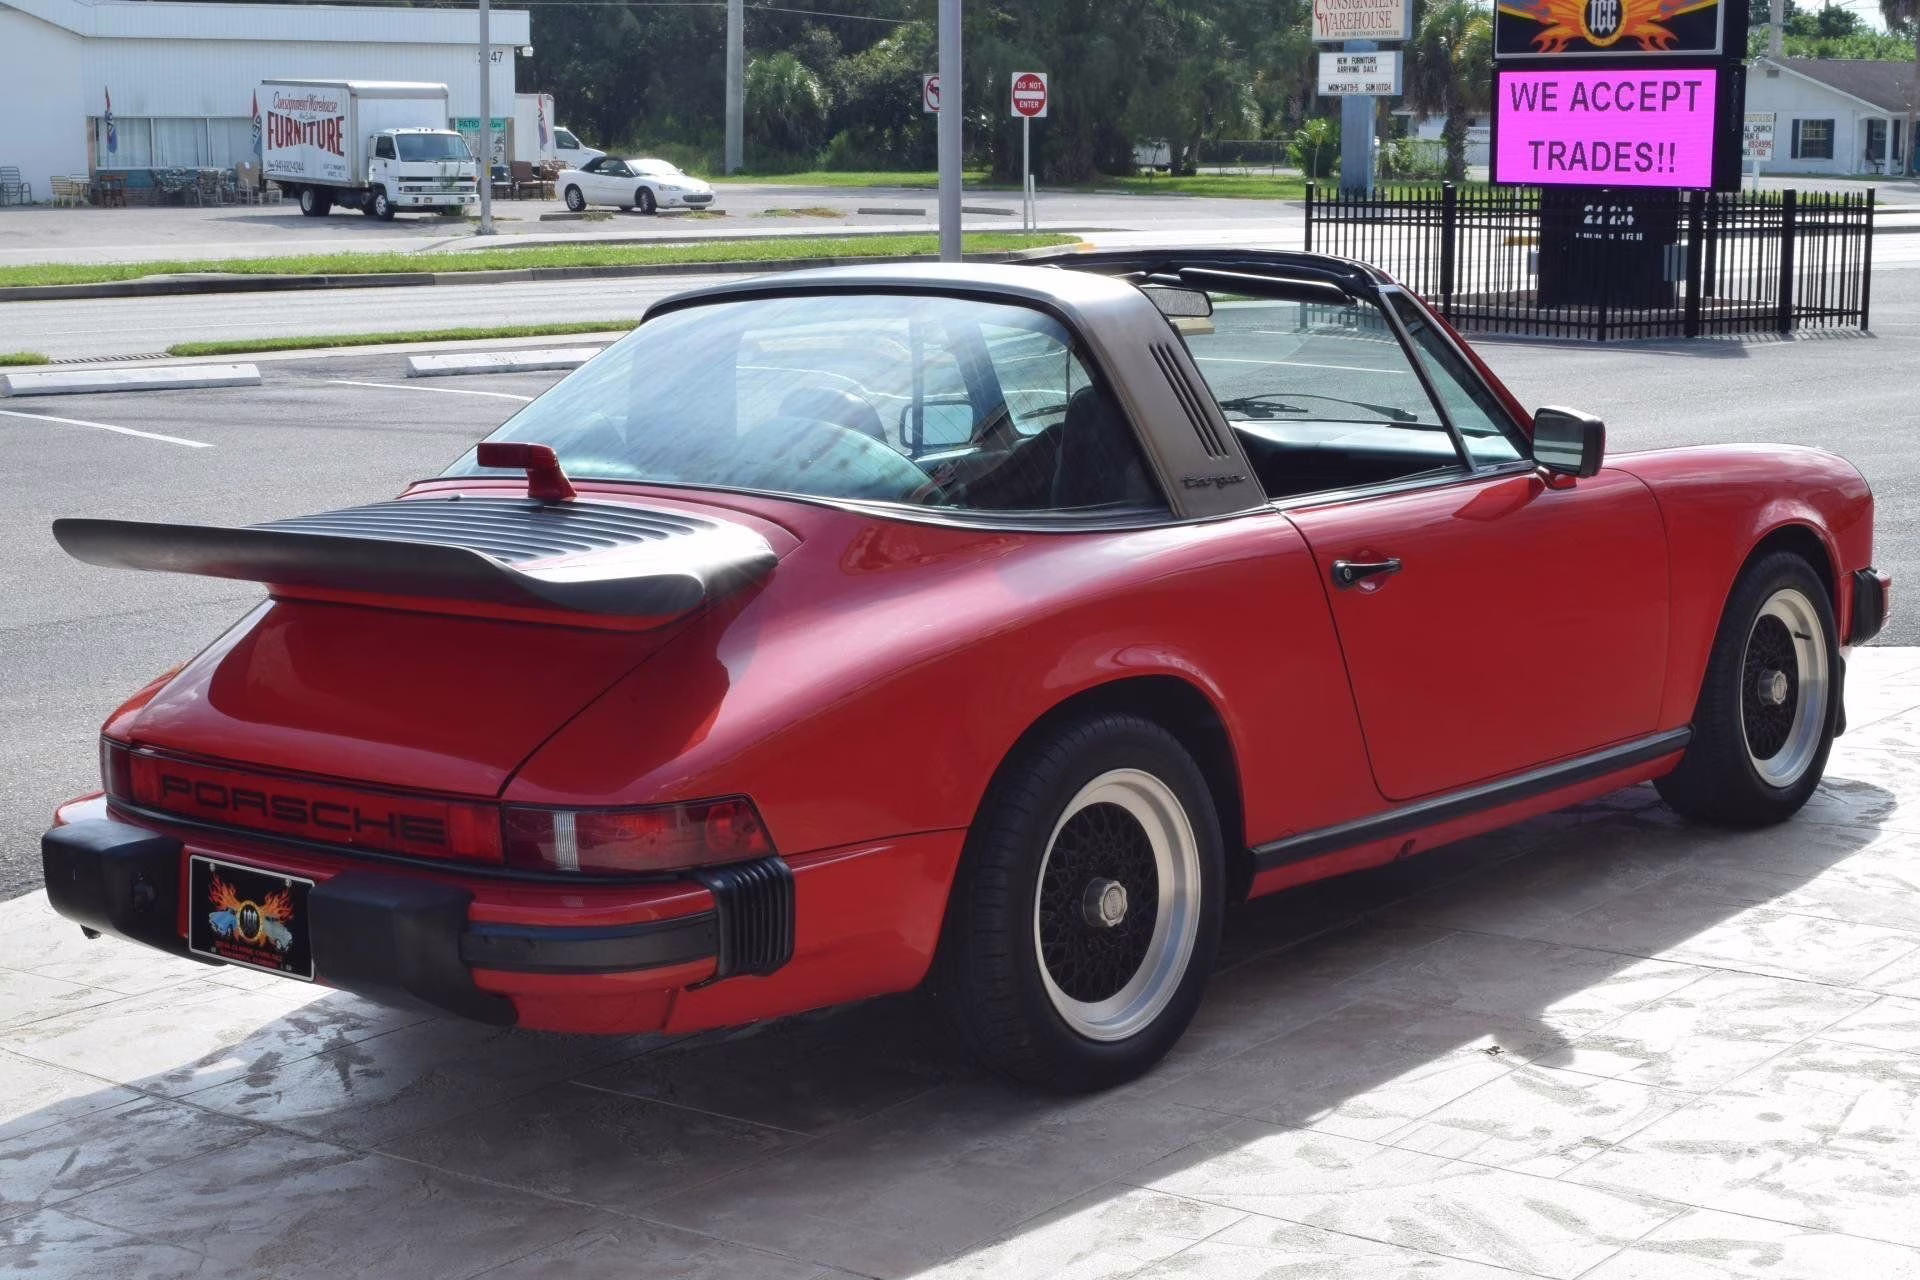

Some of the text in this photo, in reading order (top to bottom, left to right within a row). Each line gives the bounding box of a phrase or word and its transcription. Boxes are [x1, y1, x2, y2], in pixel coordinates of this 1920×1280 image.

[1319, 10, 1392, 36] WAREHOUSE
[1363, 65, 1378, 73] DAILY
[1019, 101, 1039, 109] ENTER
[1510, 80, 1702, 112] WE ACCEPT
[267, 111, 345, 157] FURNITURE
[458, 120, 480, 128] PATIO
[1528, 141, 1675, 173] TRADES!!
[161, 775, 446, 845] PORSCHE
